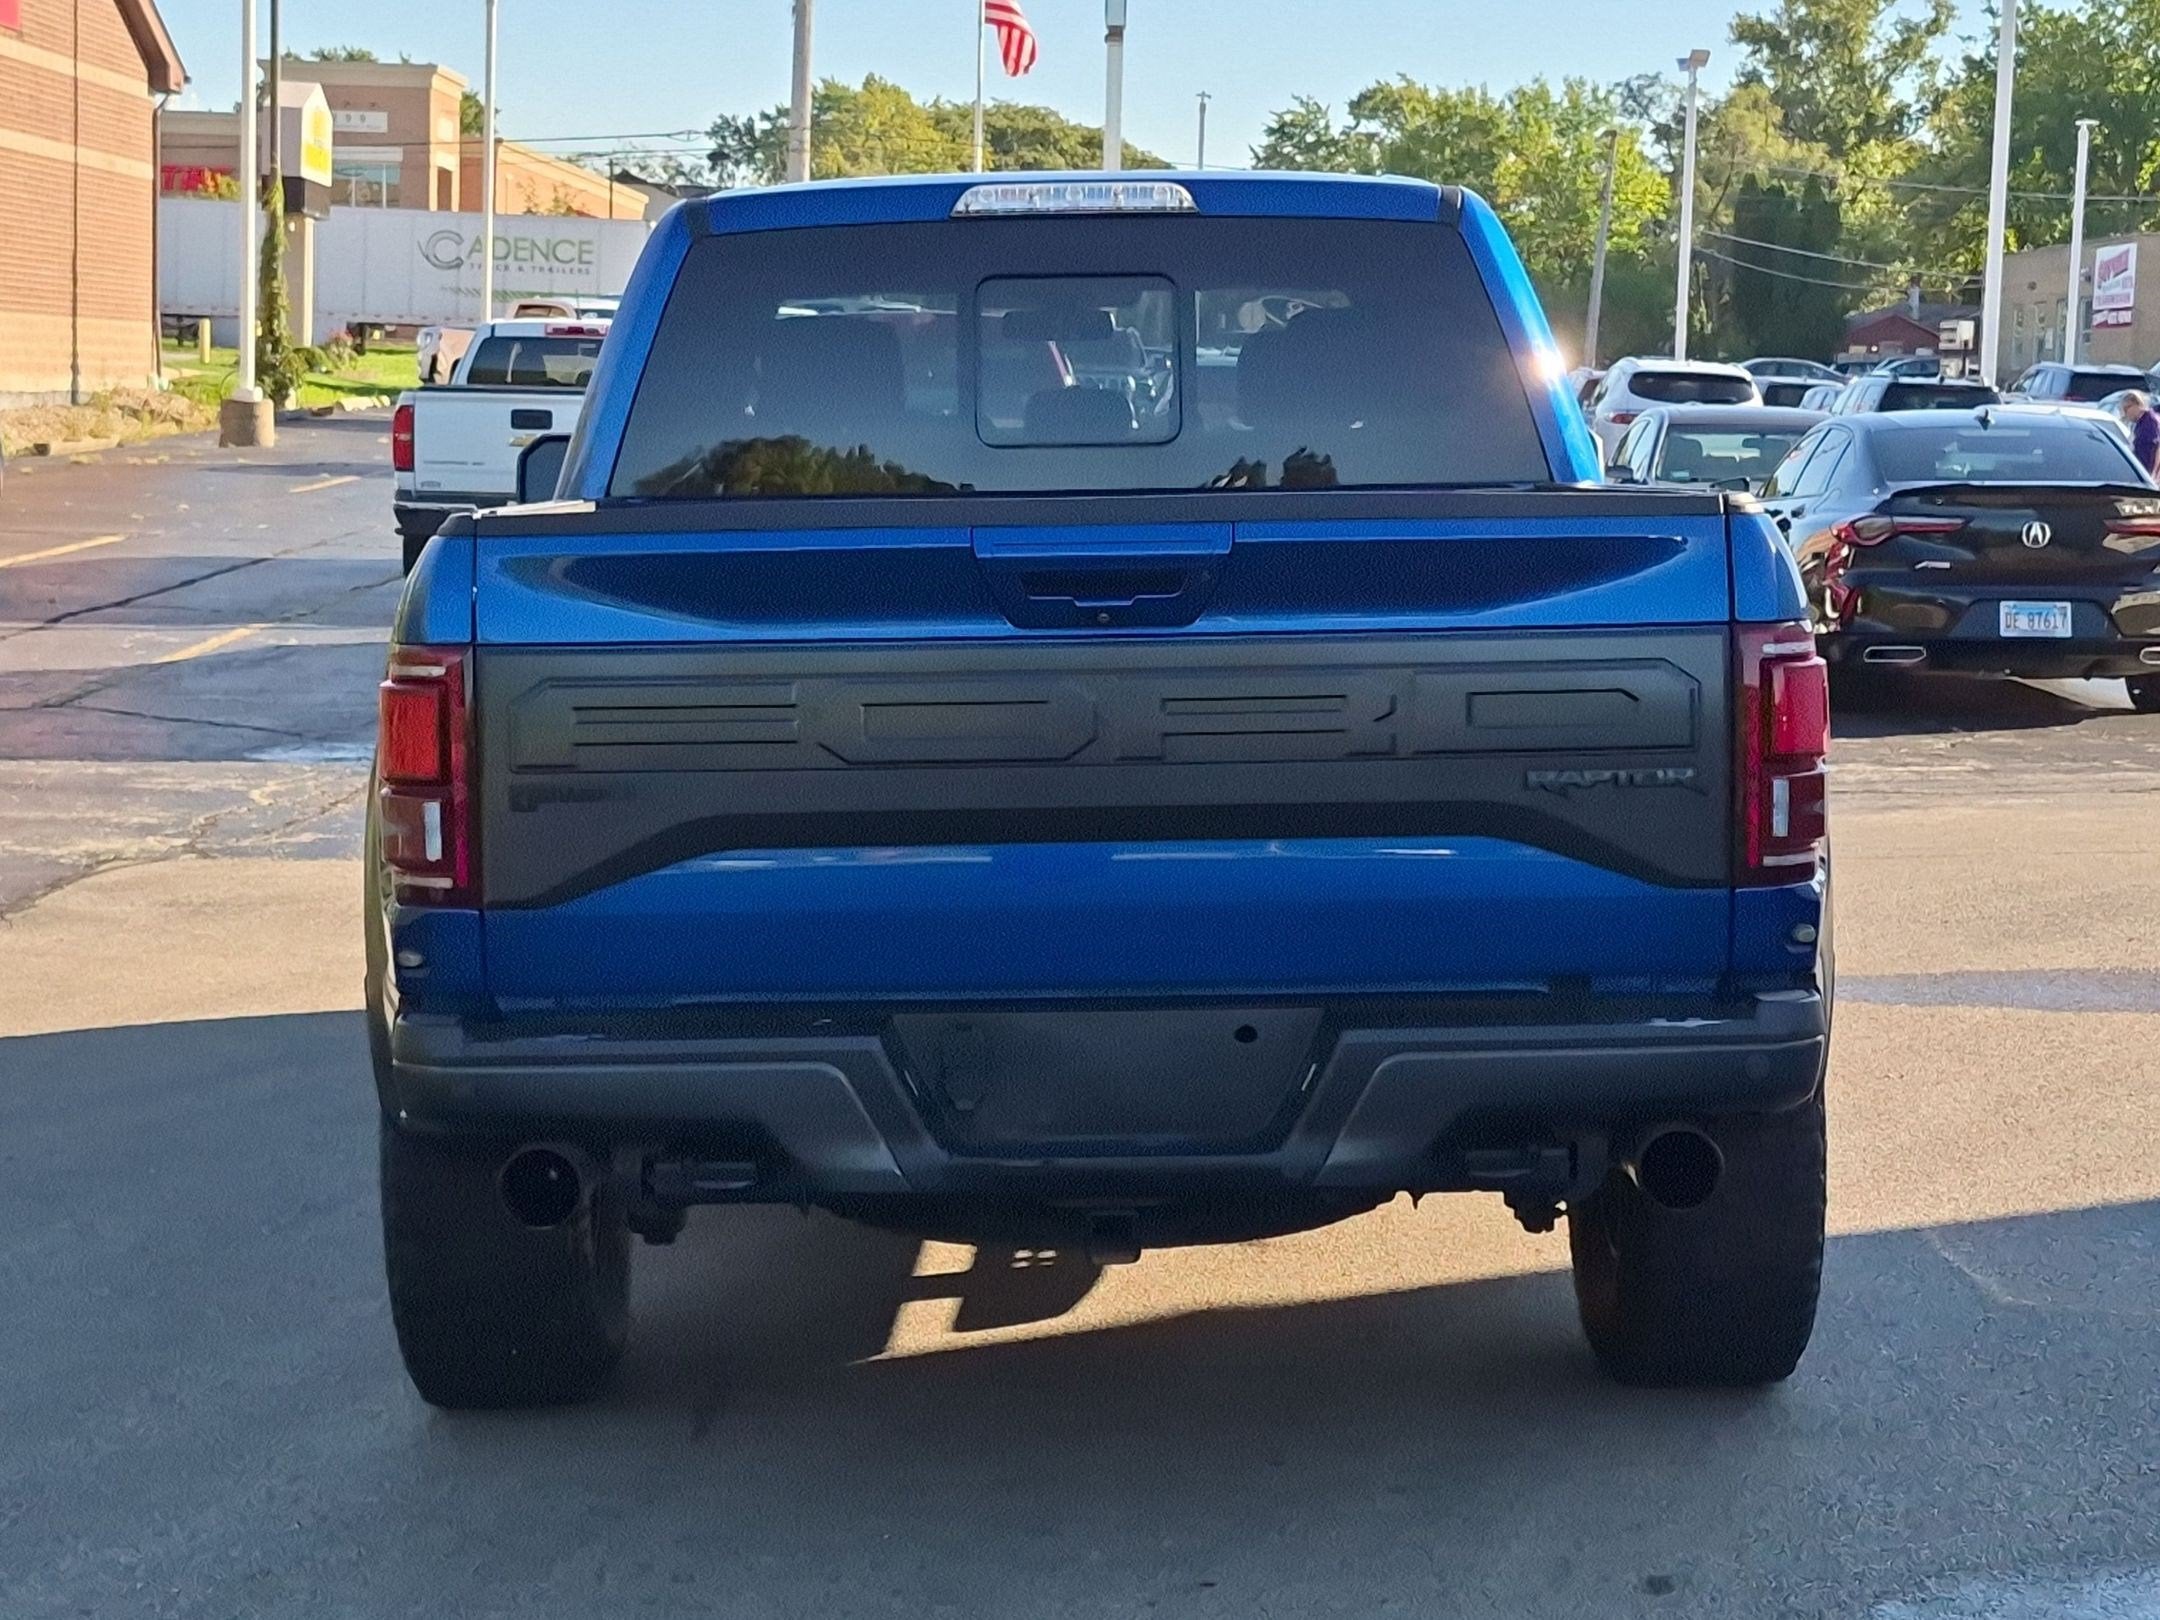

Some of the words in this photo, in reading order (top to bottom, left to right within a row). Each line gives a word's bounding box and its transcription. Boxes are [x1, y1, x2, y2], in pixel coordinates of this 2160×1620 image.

[418, 230, 594, 270] CADENCE
[509, 658, 1702, 774] FORD
[1525, 767, 1707, 797] RAPTOR
